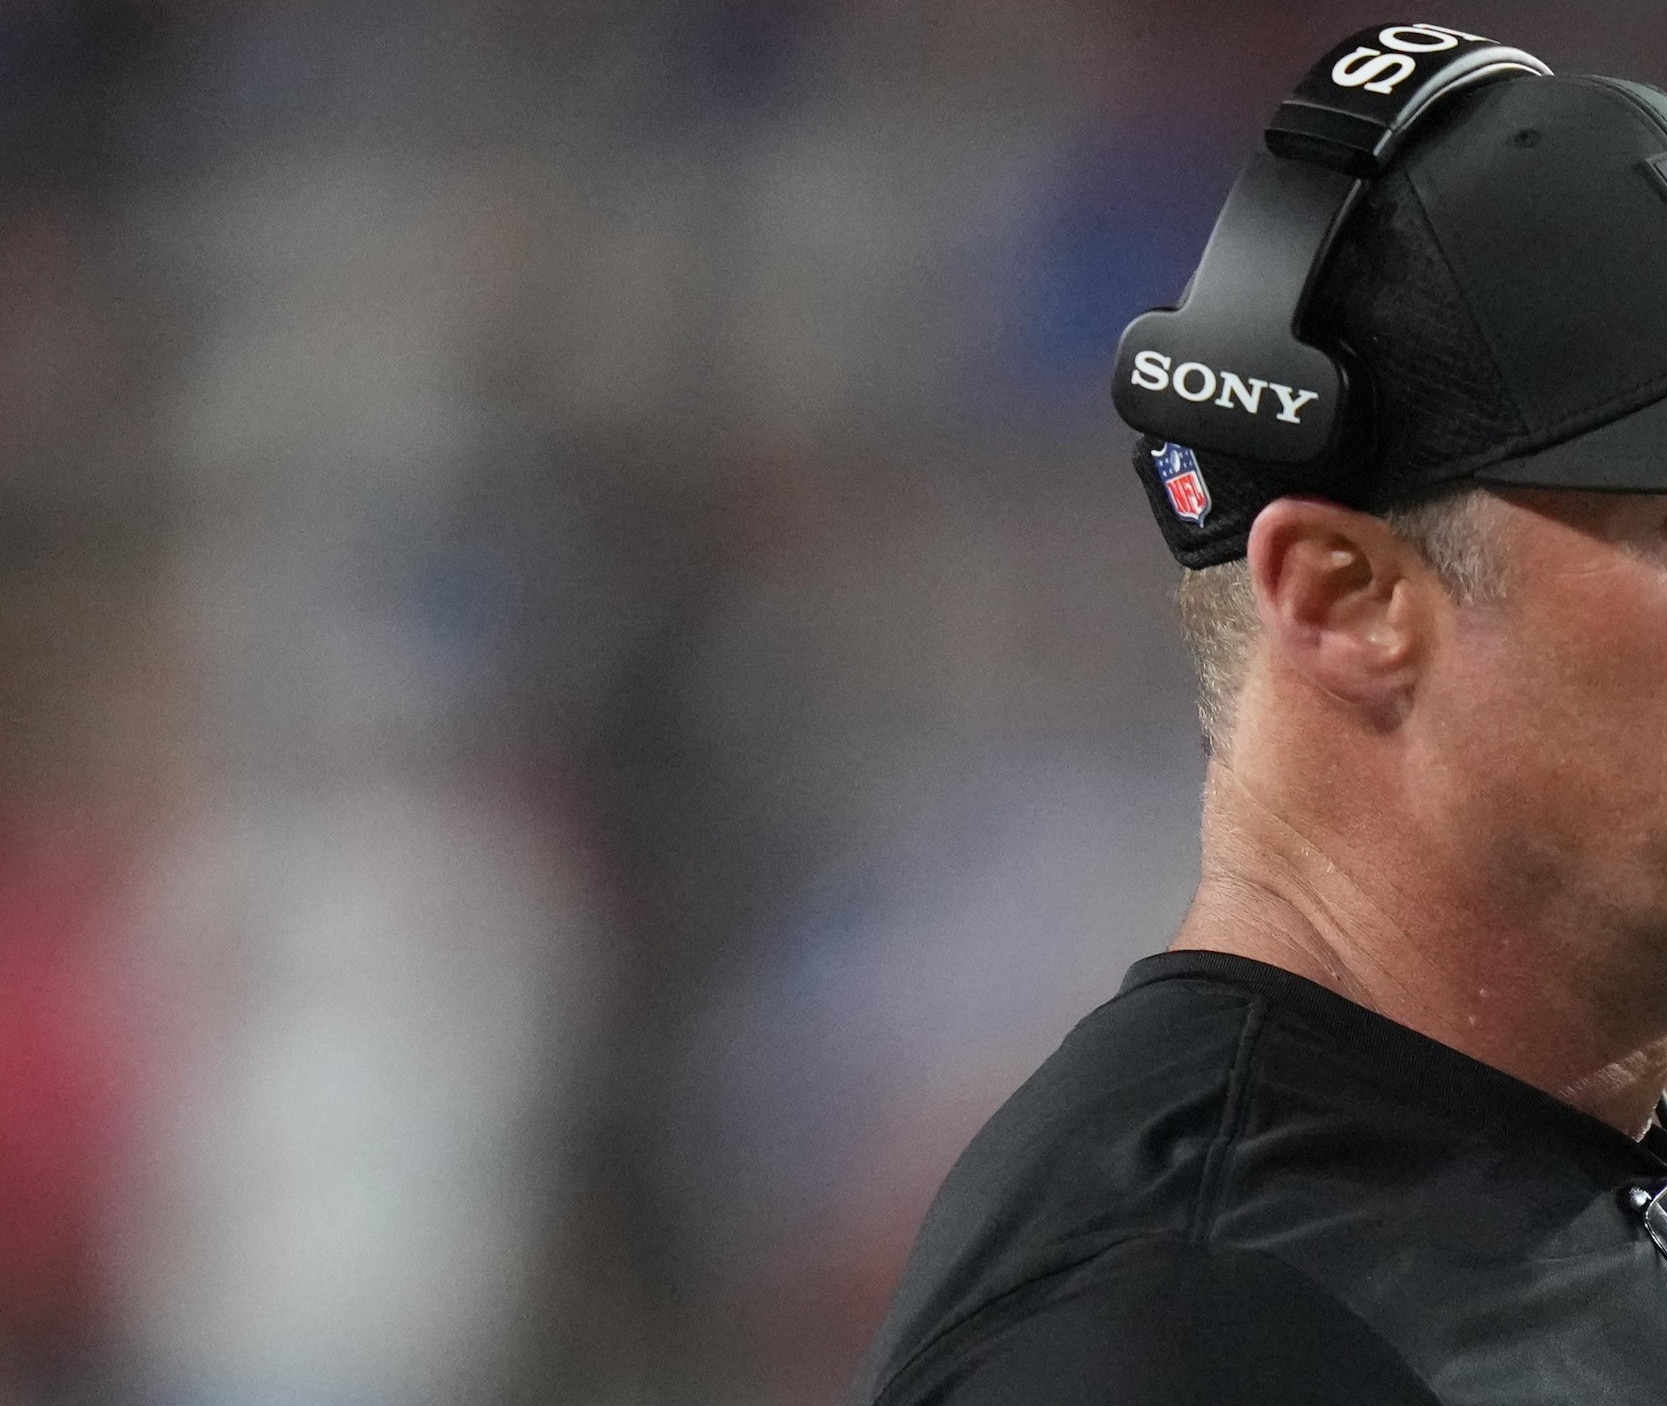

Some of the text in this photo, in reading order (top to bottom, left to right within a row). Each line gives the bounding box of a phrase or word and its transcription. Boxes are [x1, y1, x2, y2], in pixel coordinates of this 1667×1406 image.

[1332, 23, 1500, 94] SO
[1131, 350, 1319, 424] SONY
[1167, 474, 1206, 515] NFL
